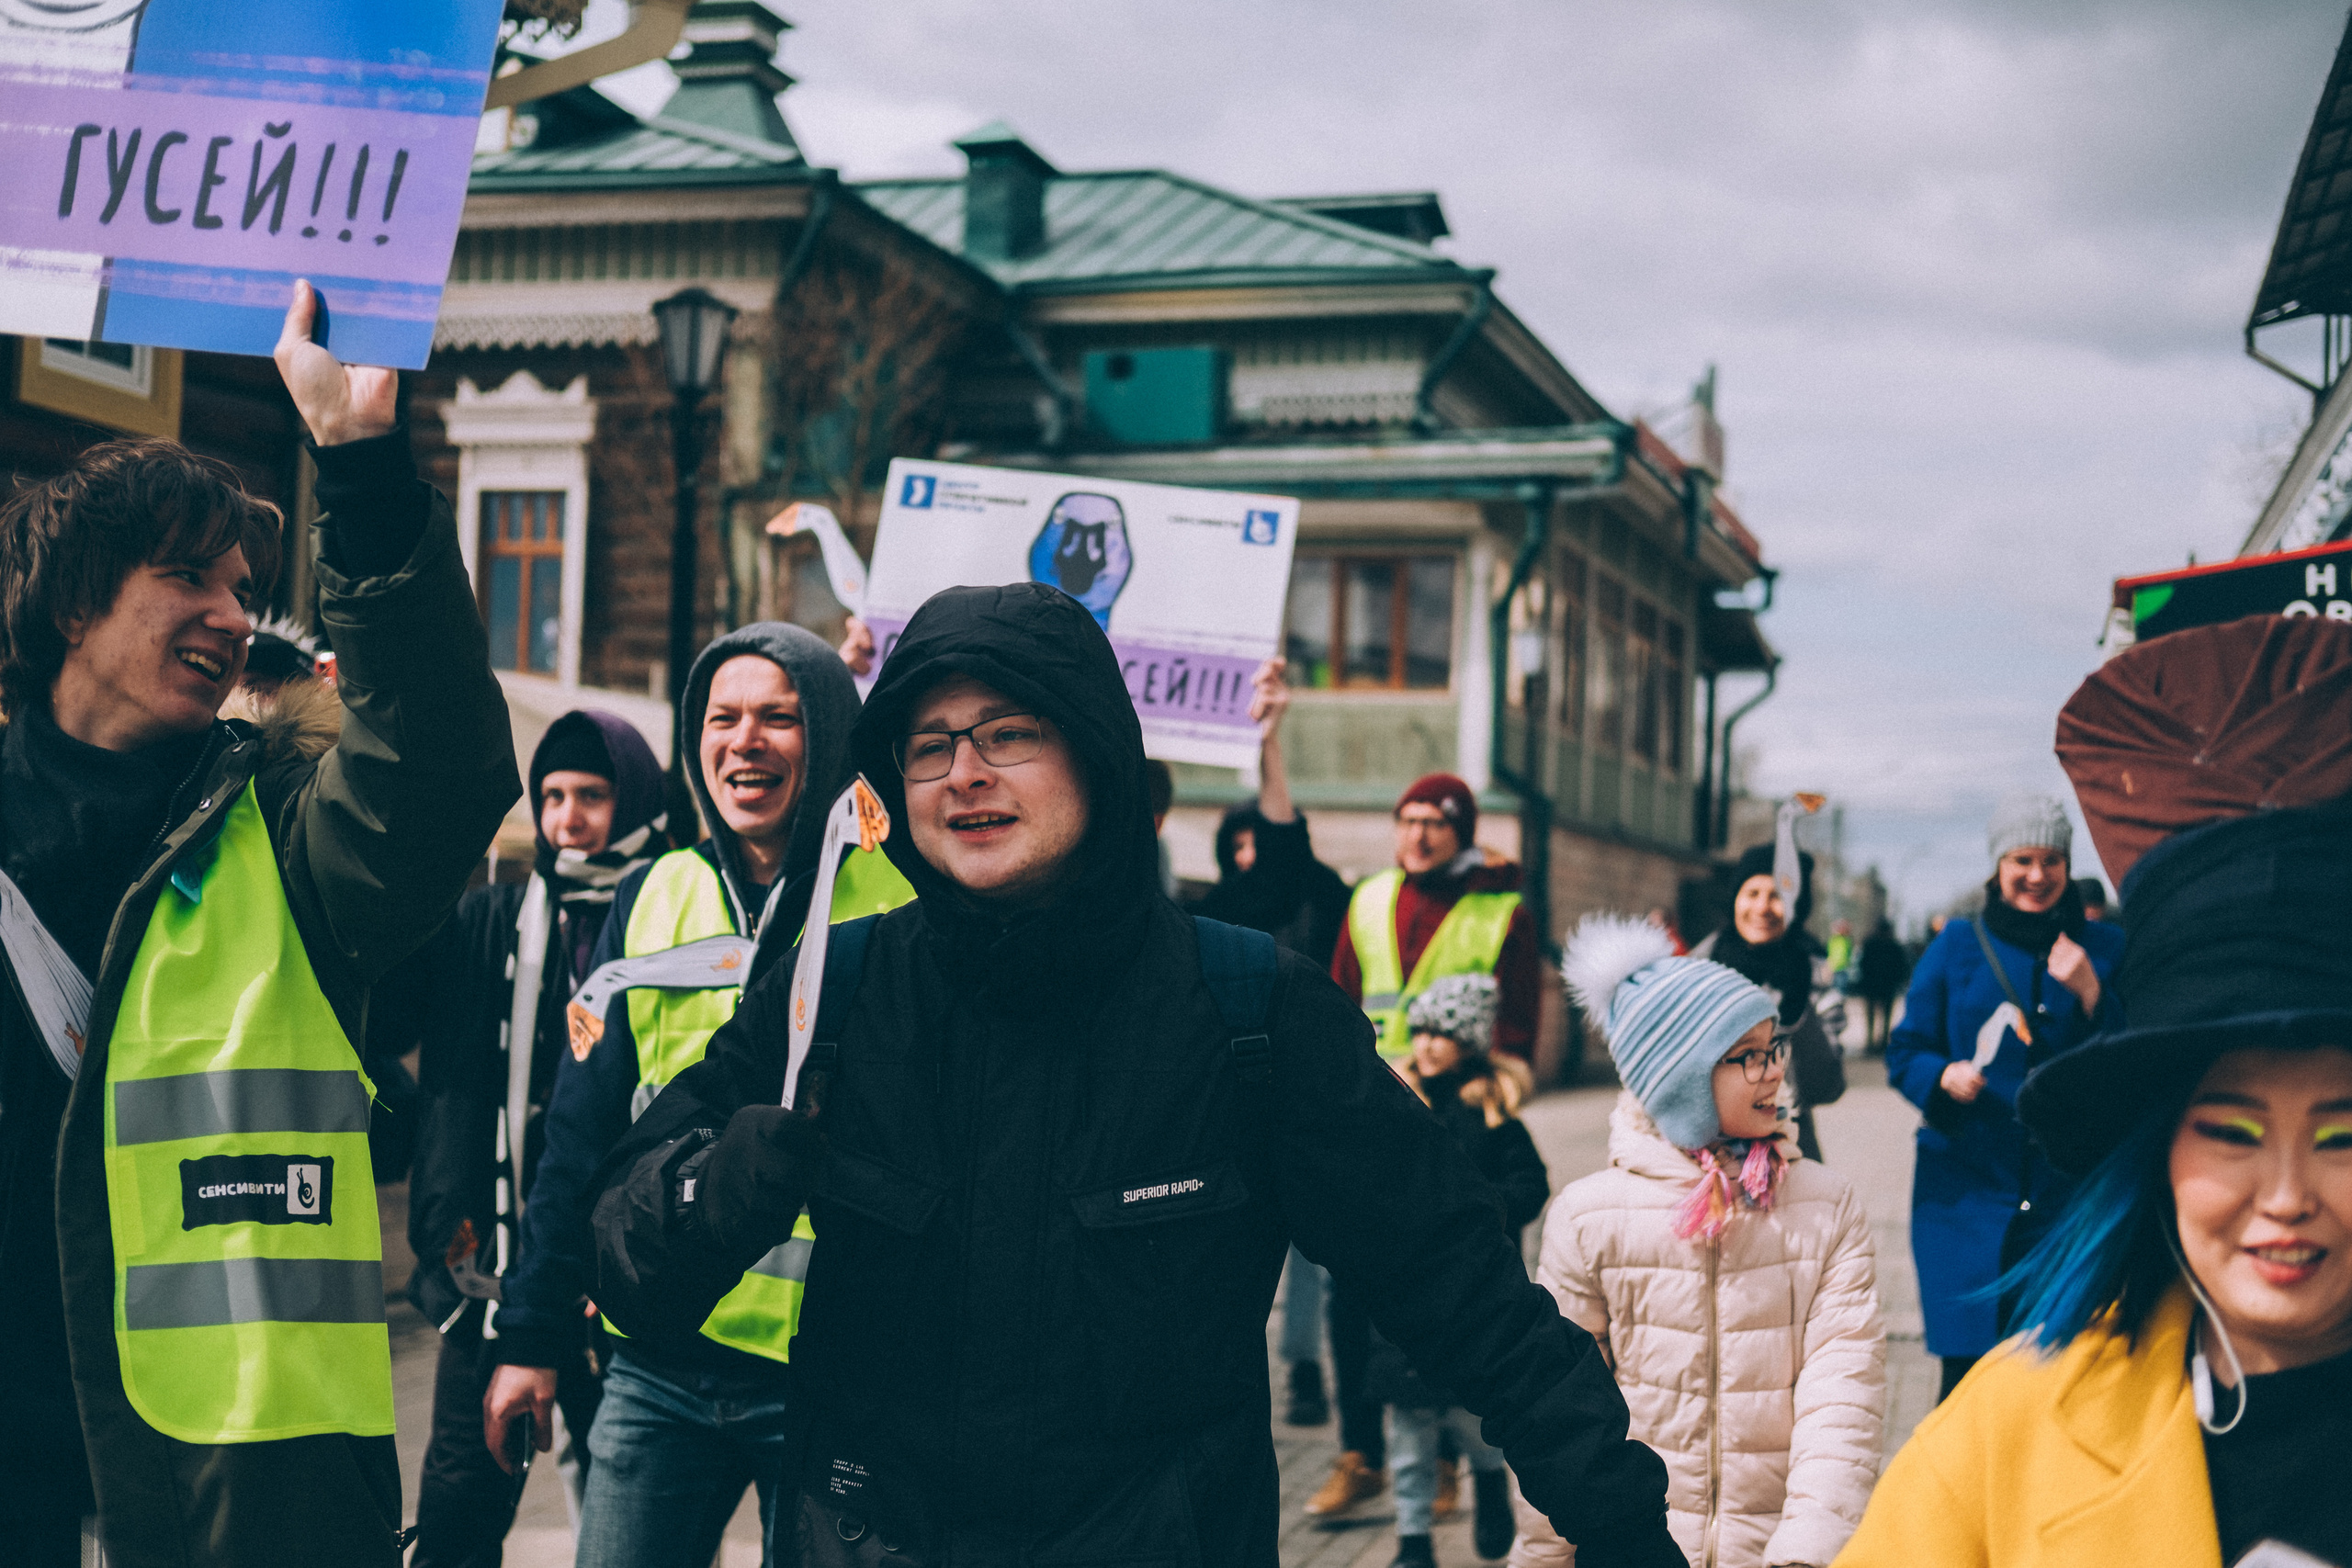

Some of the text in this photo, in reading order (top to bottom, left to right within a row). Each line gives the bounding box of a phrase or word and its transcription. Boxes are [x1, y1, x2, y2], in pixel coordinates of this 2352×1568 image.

[58, 120, 410, 245] ГУСЕЙ!!!
[198, 1182, 286, 1199] СЕНСИВИТИ
[1123, 1179, 1204, 1203] SUPERIOR RAPID+
